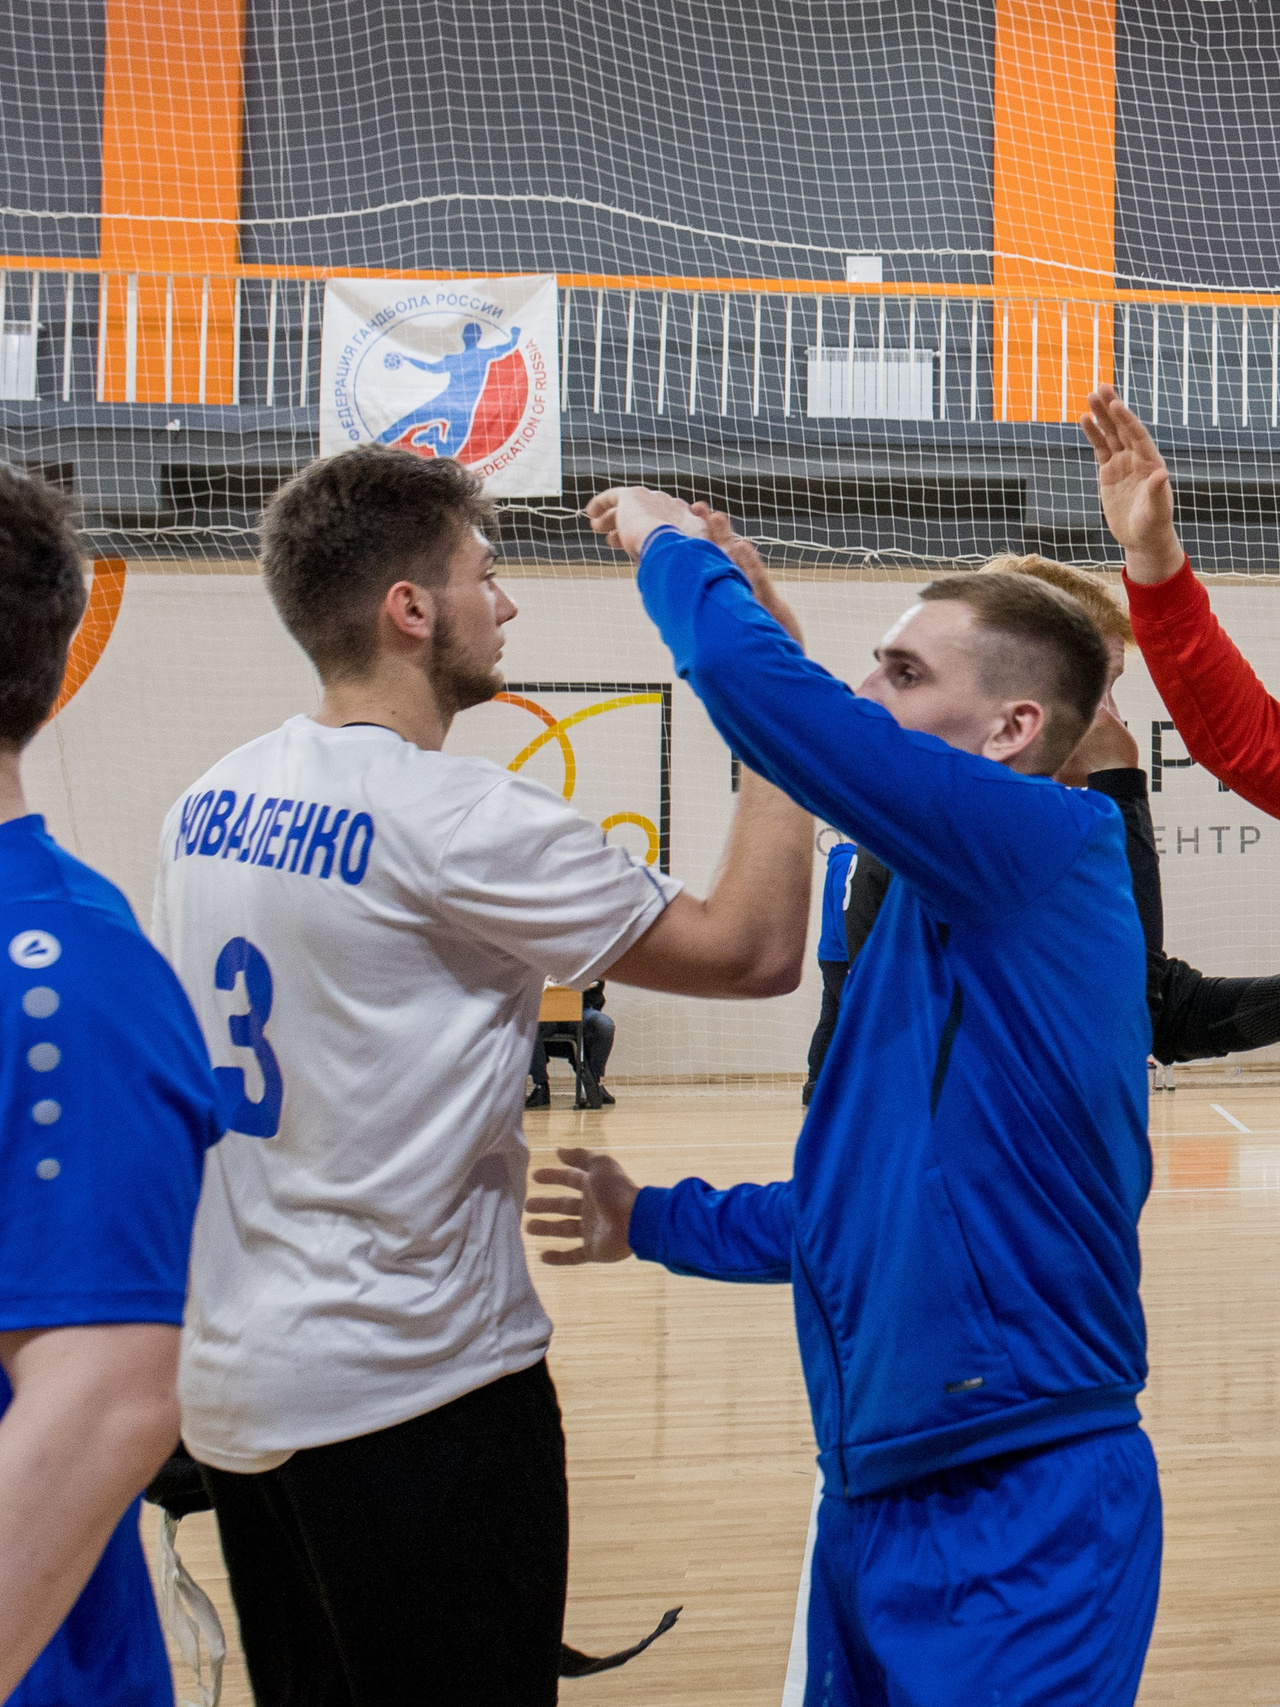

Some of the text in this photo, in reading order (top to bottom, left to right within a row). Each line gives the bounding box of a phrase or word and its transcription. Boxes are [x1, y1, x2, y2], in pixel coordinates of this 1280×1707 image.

[335, 293, 504, 441] ФЕДЕРАЦИЯ ГАНДБОЛА РОССИИ
[474, 338, 547, 479] EDERATION OF RUSSIA
[174, 789, 374, 886] КОВАЛЕНКО
[213, 936, 284, 1139] 3
